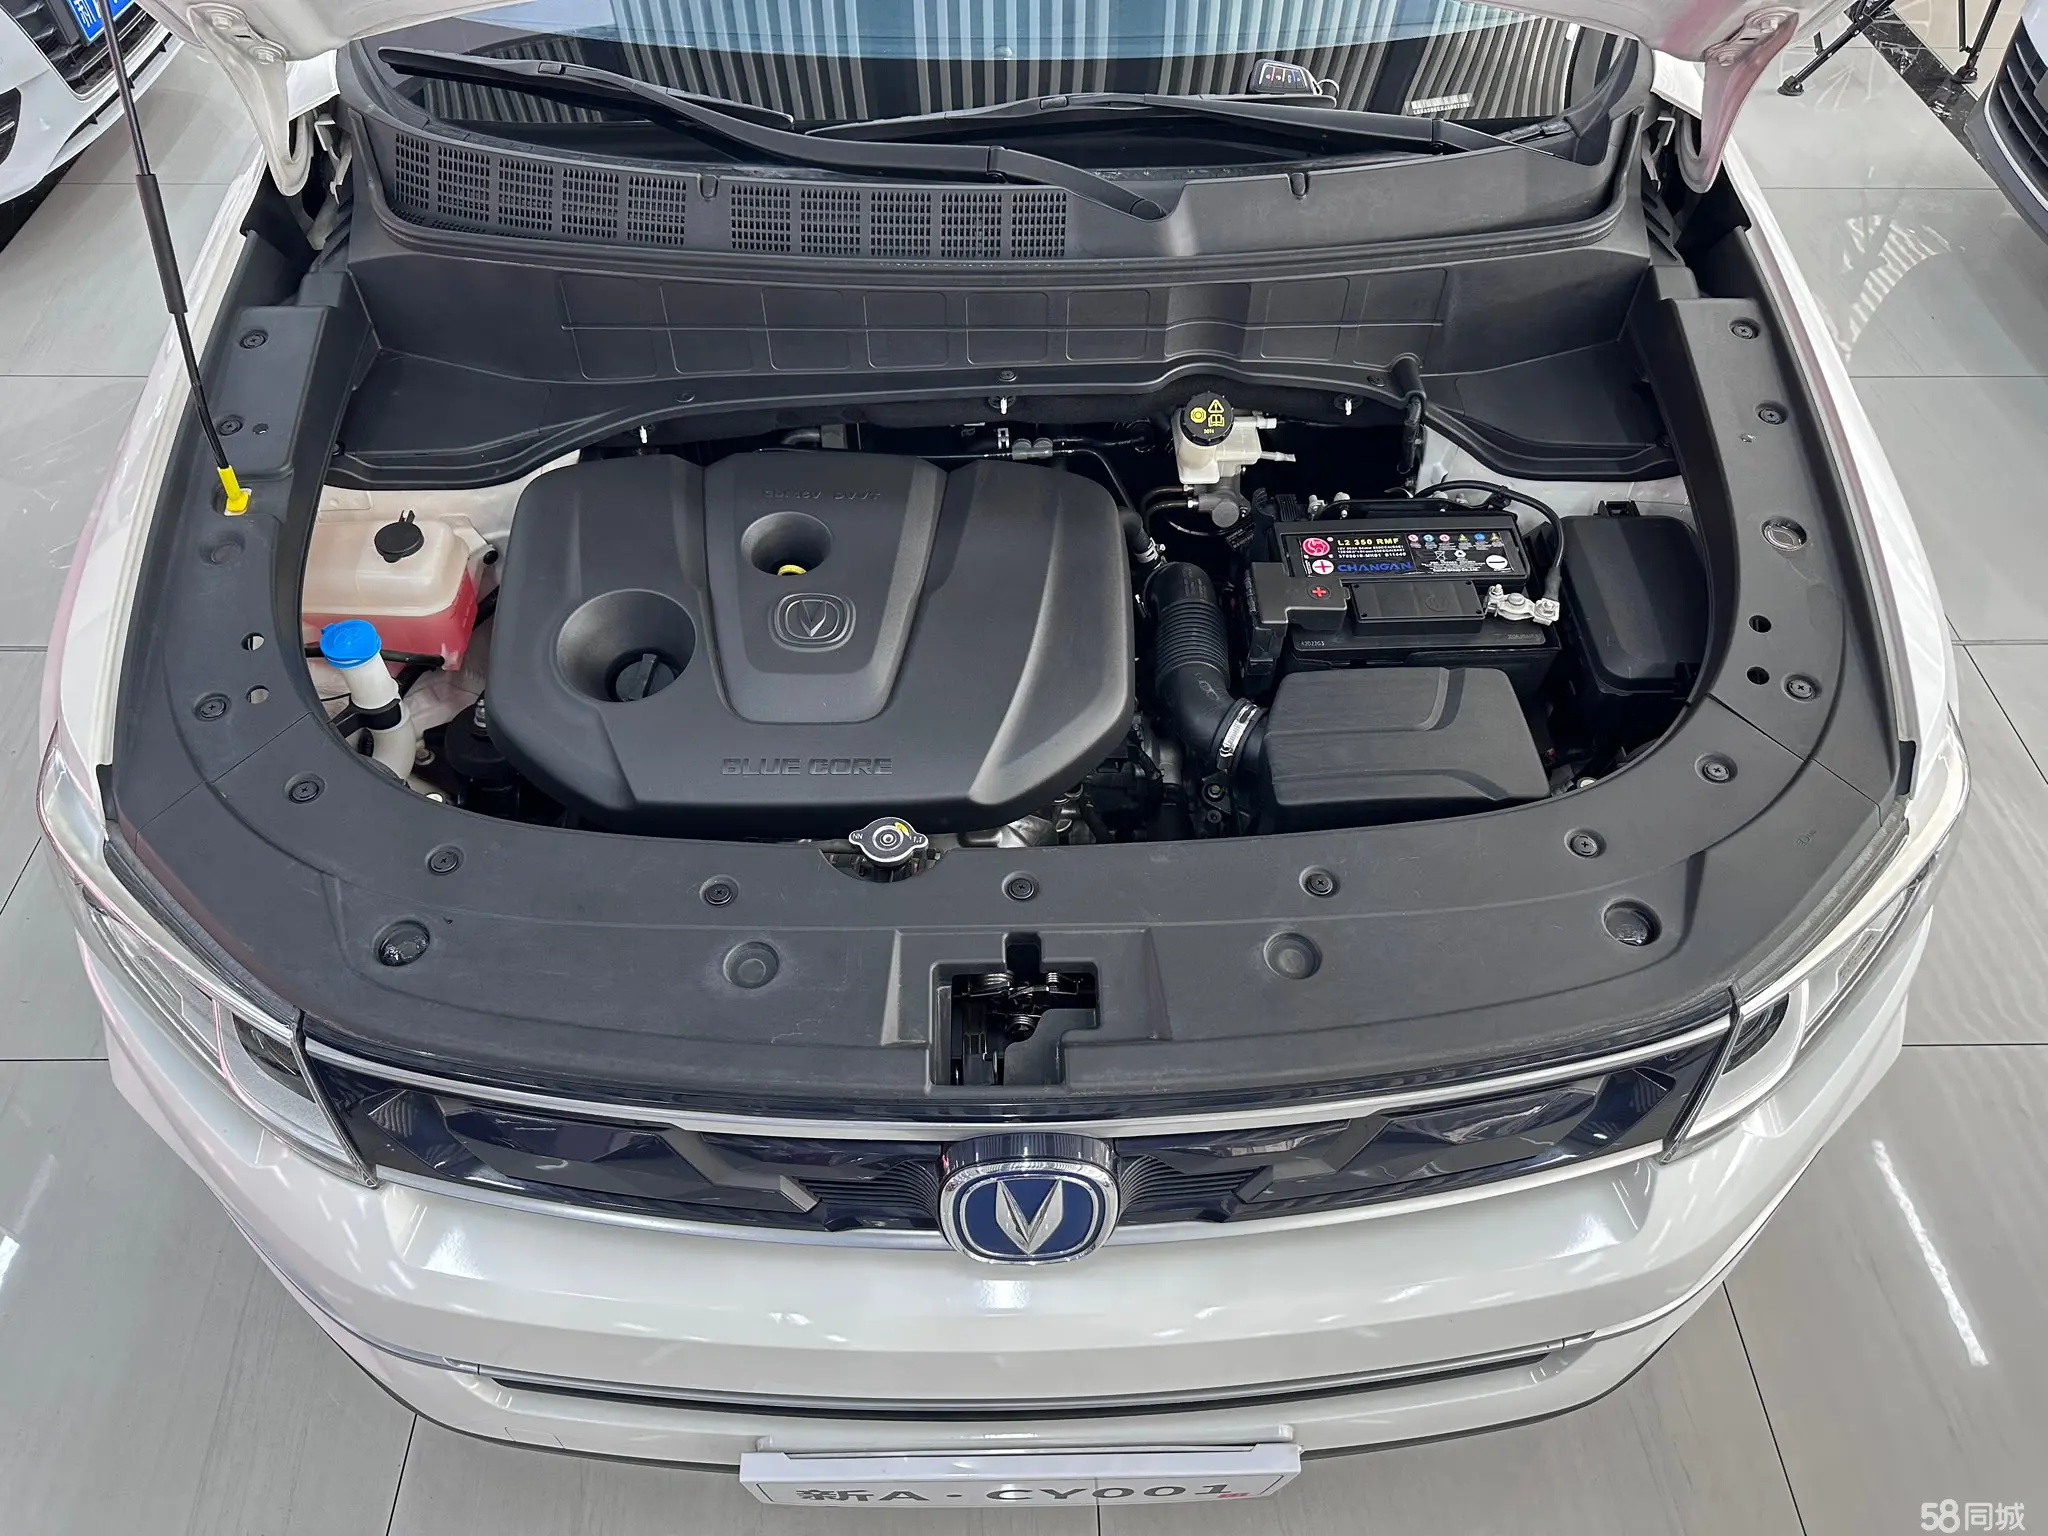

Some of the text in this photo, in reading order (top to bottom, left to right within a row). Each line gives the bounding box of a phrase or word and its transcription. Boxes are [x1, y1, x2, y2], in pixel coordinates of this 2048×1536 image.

[1376, 537, 1400, 545] RMF
[1337, 561, 1413, 573] CHANGAN
[721, 757, 893, 775] BLUE CORE
